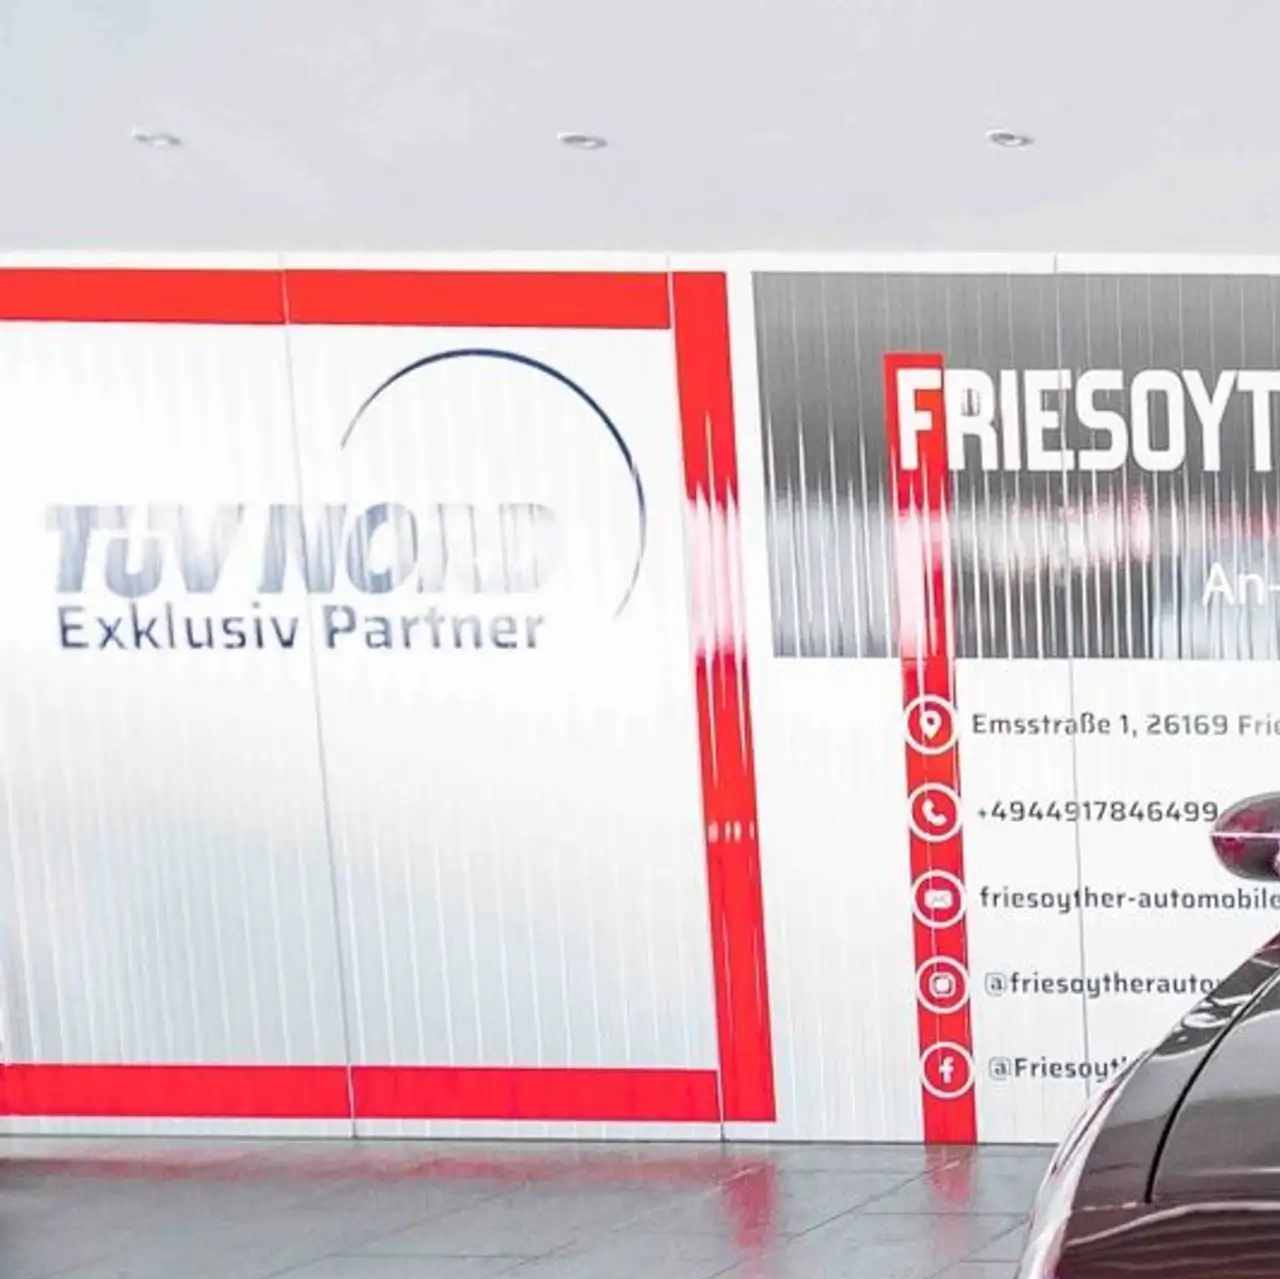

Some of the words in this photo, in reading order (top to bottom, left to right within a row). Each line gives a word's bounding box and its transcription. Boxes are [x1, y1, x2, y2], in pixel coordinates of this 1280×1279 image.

[57, 601, 299, 650] Exklusiv
[322, 603, 545, 650] Partner
[972, 712, 1111, 736] Emsstraße
[1120, 714, 1138, 739] 1,
[1146, 714, 1229, 736] 26169
[976, 800, 1219, 823] +4944917846499
[989, 1055, 1127, 1083] @Friesoyt
